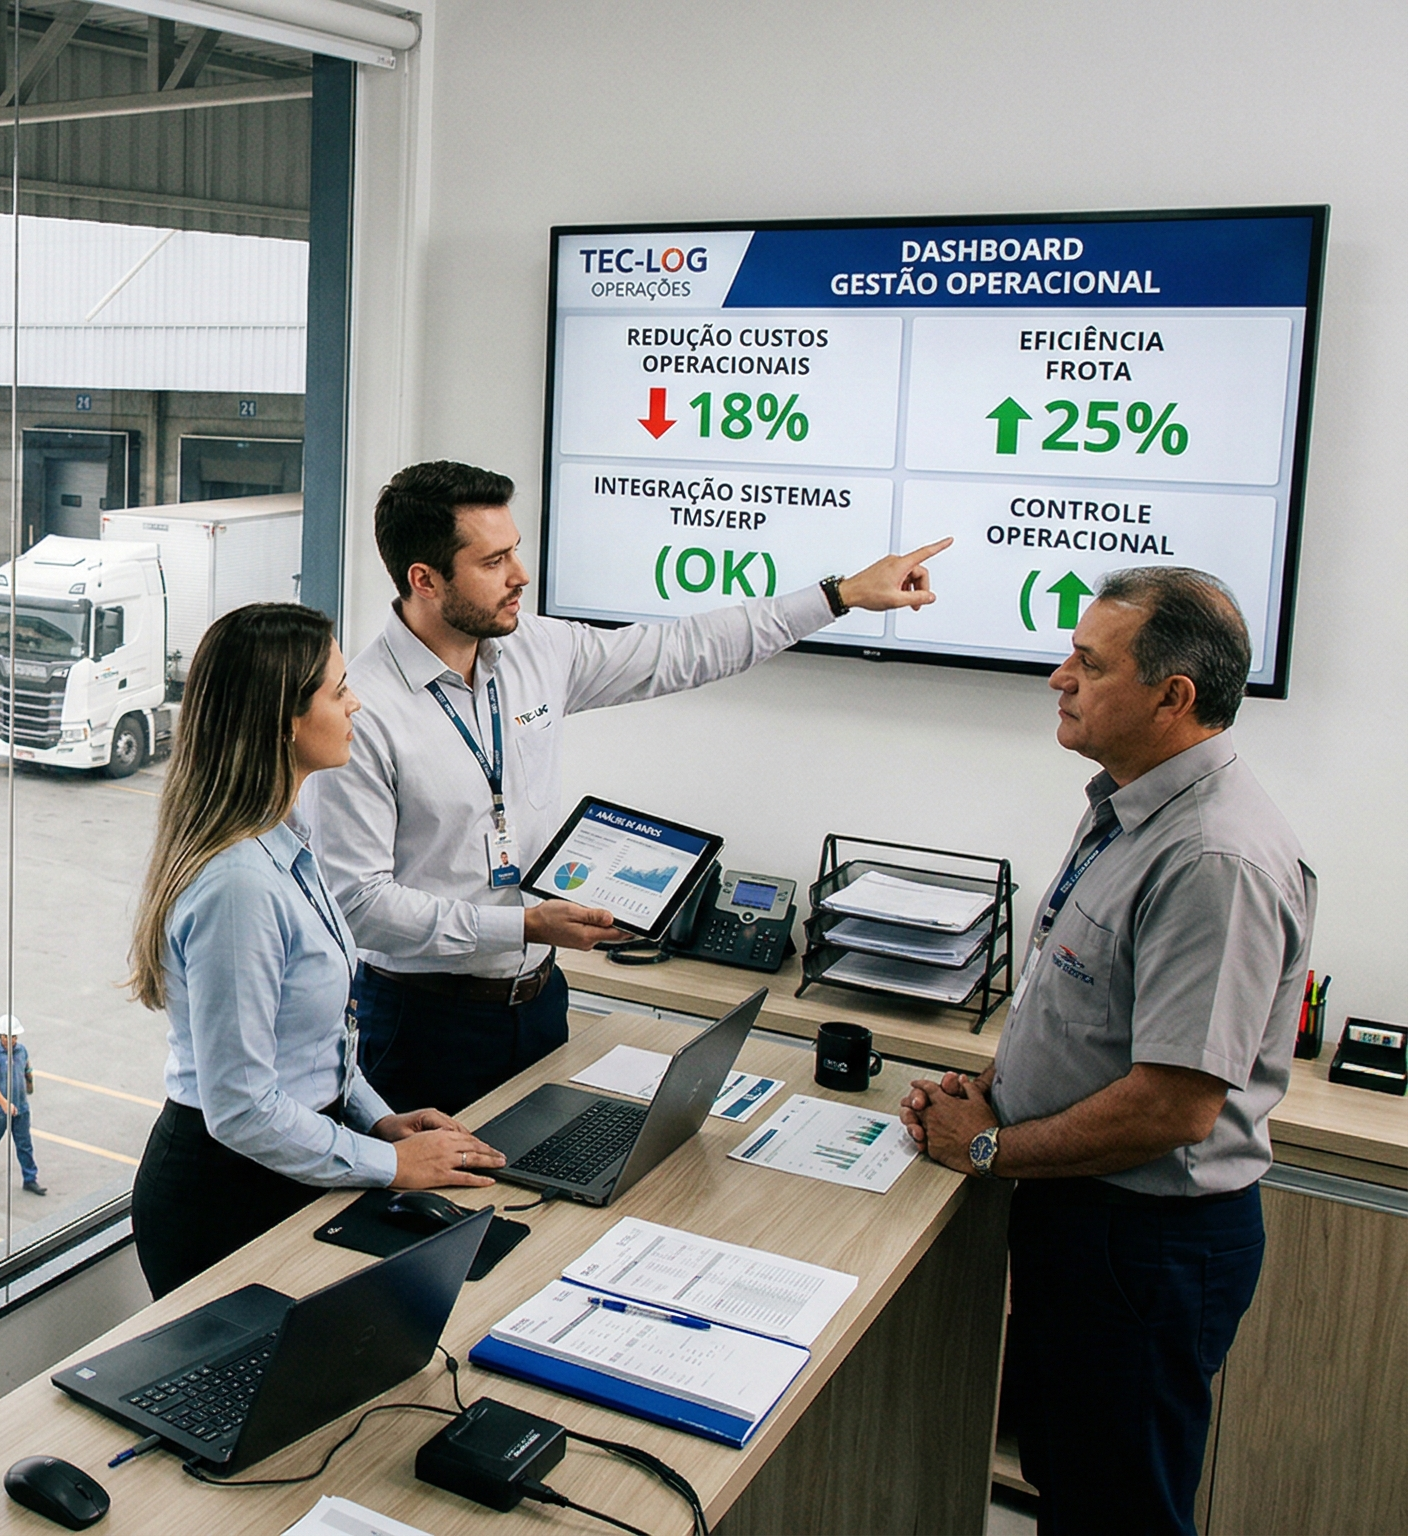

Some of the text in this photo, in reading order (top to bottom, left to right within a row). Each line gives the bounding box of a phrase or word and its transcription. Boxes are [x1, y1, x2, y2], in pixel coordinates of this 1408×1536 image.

[580, 246, 708, 275] TEC-LOG
[901, 237, 1084, 266] DASHBOARD
[591, 277, 691, 302] OPERAÇÕES
[830, 267, 1161, 297] GESTÃO OPERACIONAL
[626, 323, 829, 352] REDUÇÃO CUSTOS
[1019, 325, 1165, 353] EFICIÊNCIA
[642, 354, 811, 377] OPERACIONAIS
[1045, 359, 1133, 382] FROTA
[688, 391, 810, 443] 18%
[1041, 399, 1190, 456] 25%
[593, 476, 852, 509] INTEGRAÇÃO SISTEMAS
[669, 506, 768, 532] TMS/ERP
[1009, 496, 1153, 526] CONTROLE
[985, 525, 1175, 557] OPERACIONAL
[654, 545, 778, 601] (OK)
